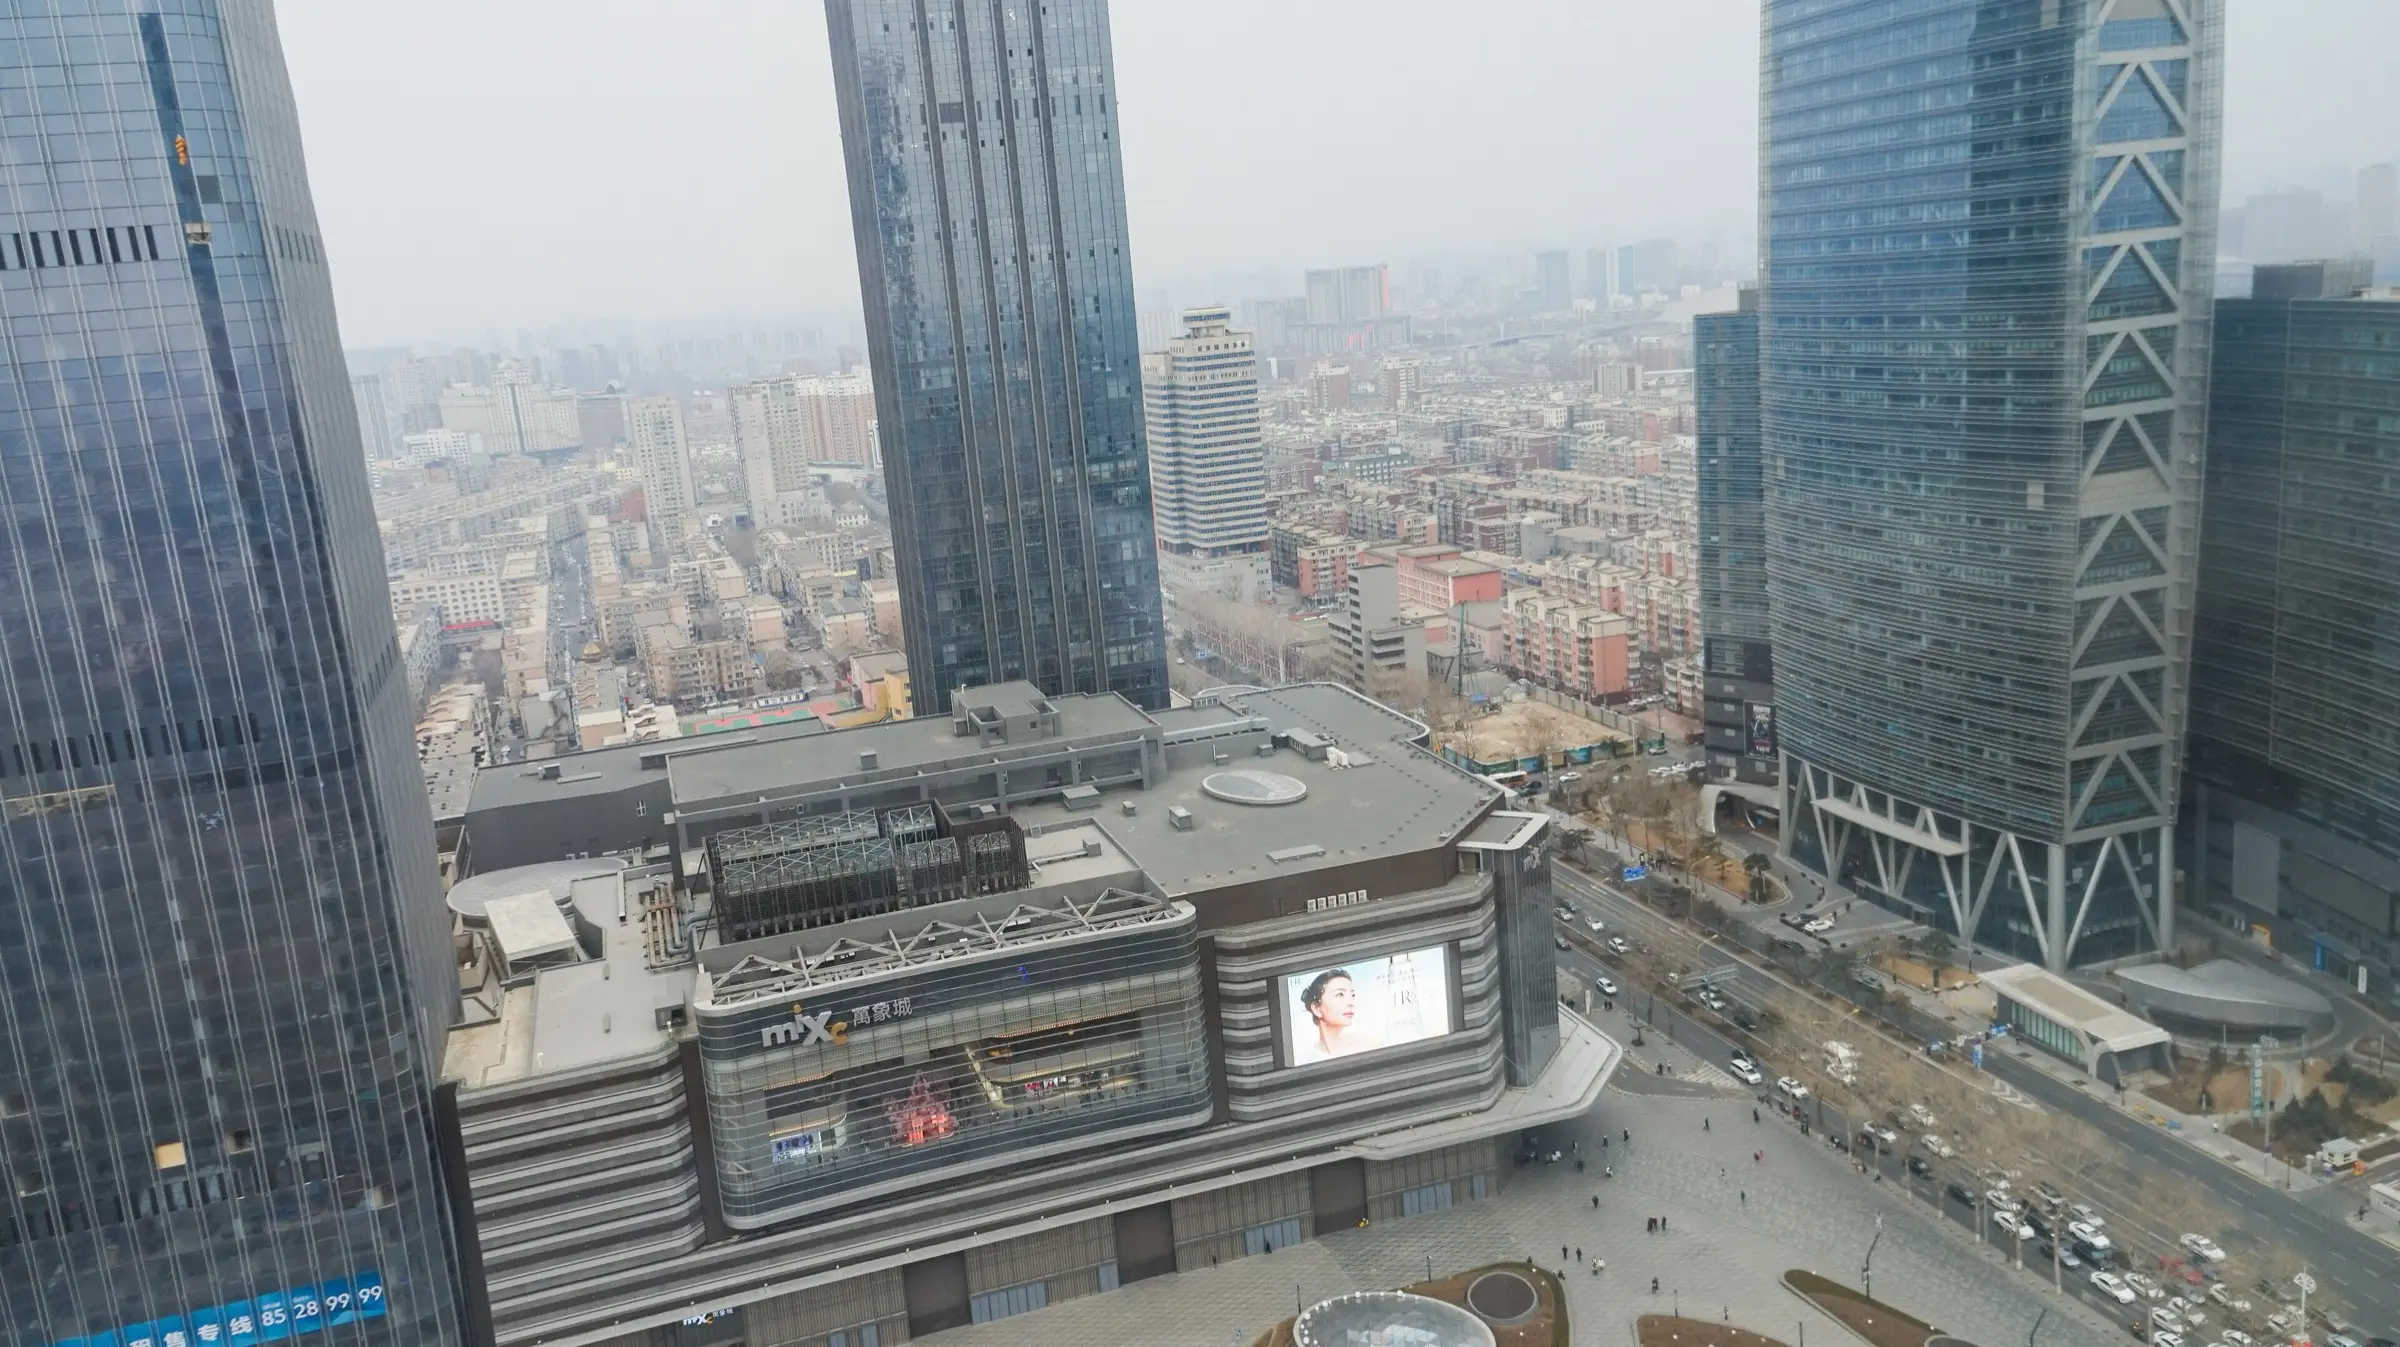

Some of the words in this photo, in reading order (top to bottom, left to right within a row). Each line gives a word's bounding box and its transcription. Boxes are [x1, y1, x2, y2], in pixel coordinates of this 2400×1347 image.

[851, 997, 913, 1027] 萬象城
[261, 1308, 286, 1326] 85
[294, 1301, 319, 1319] 28
[326, 1293, 350, 1311] 99
[358, 1285, 383, 1303] 99
